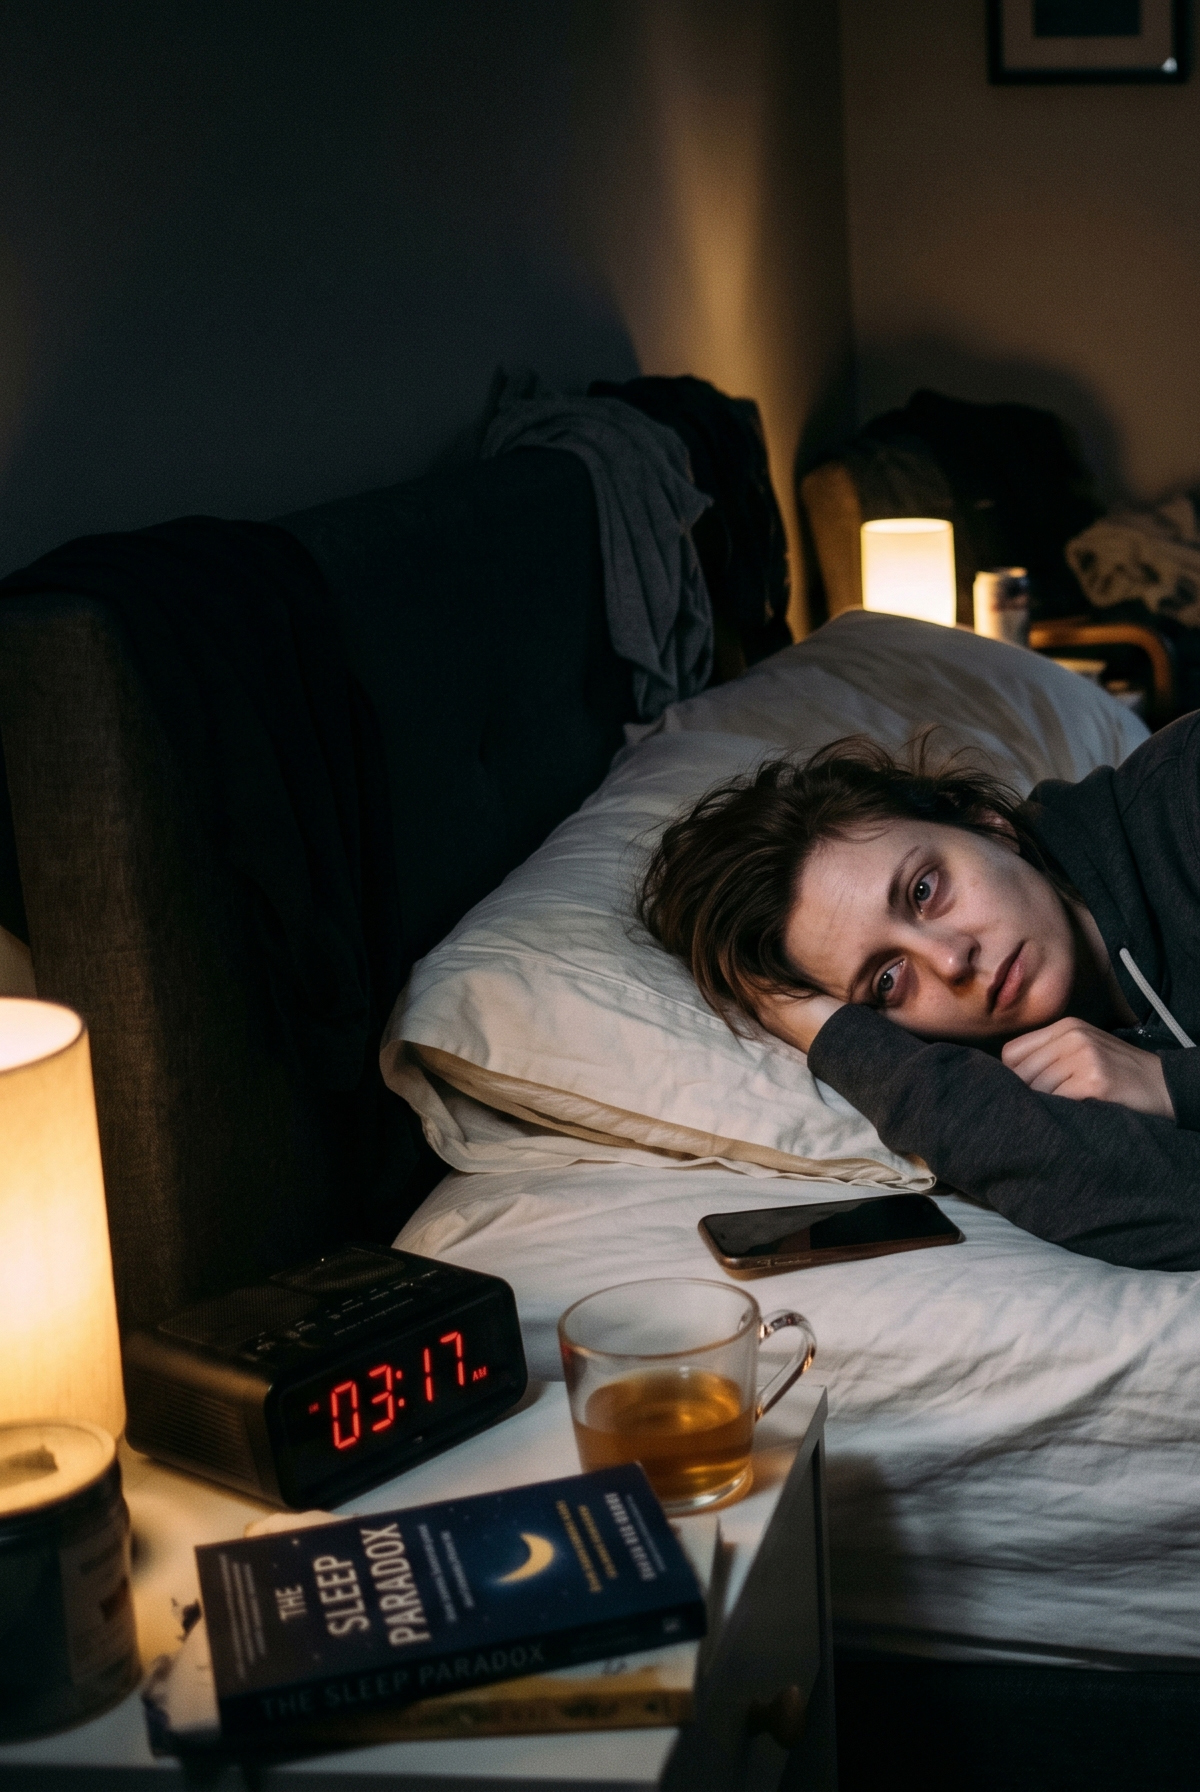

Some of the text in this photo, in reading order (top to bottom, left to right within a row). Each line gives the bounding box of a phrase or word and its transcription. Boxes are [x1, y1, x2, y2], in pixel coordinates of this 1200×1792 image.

[330, 1330, 467, 1451] 03:17
[274, 1584, 308, 1623] THE
[312, 1554, 371, 1638] SLEEP
[359, 1522, 432, 1647] PARADOX
[260, 1643, 547, 1721] THE SLEEP PARADOX
